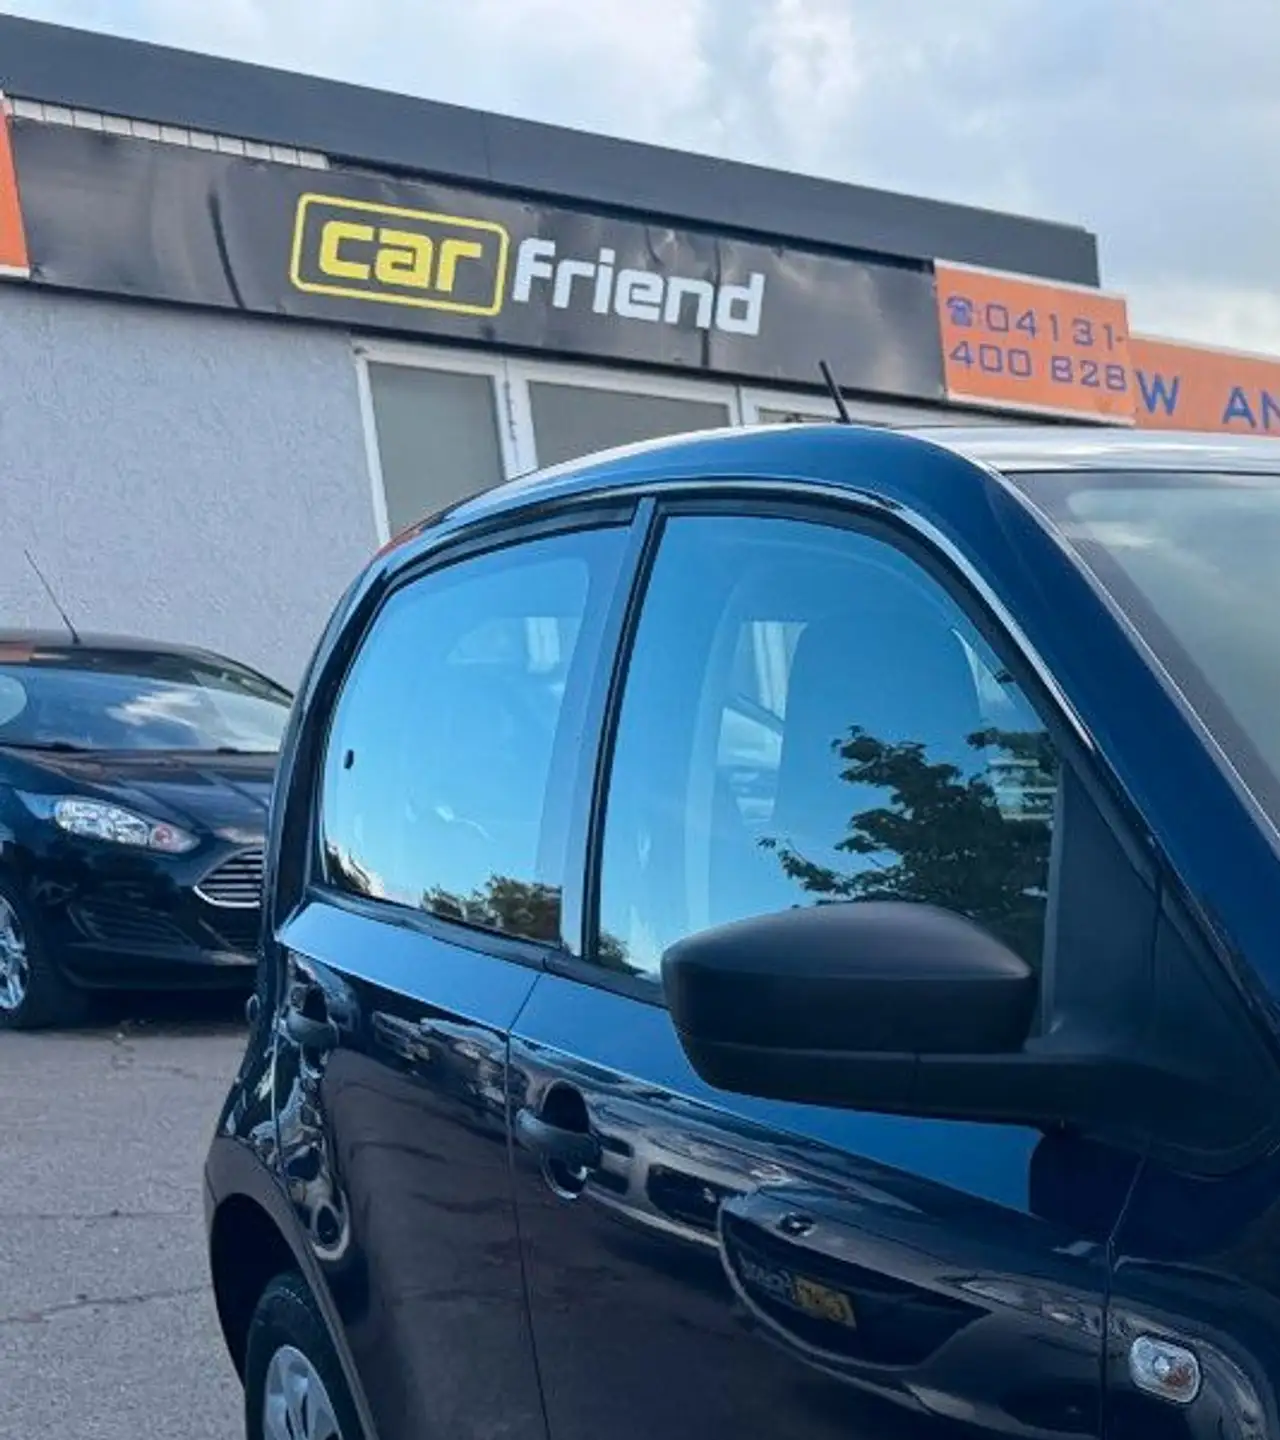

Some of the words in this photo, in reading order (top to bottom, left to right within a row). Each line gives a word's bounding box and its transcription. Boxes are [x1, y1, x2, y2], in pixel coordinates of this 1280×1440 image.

[319, 219, 482, 292] car
[949, 341, 1033, 377] 400
[1051, 355, 1126, 391] 828
